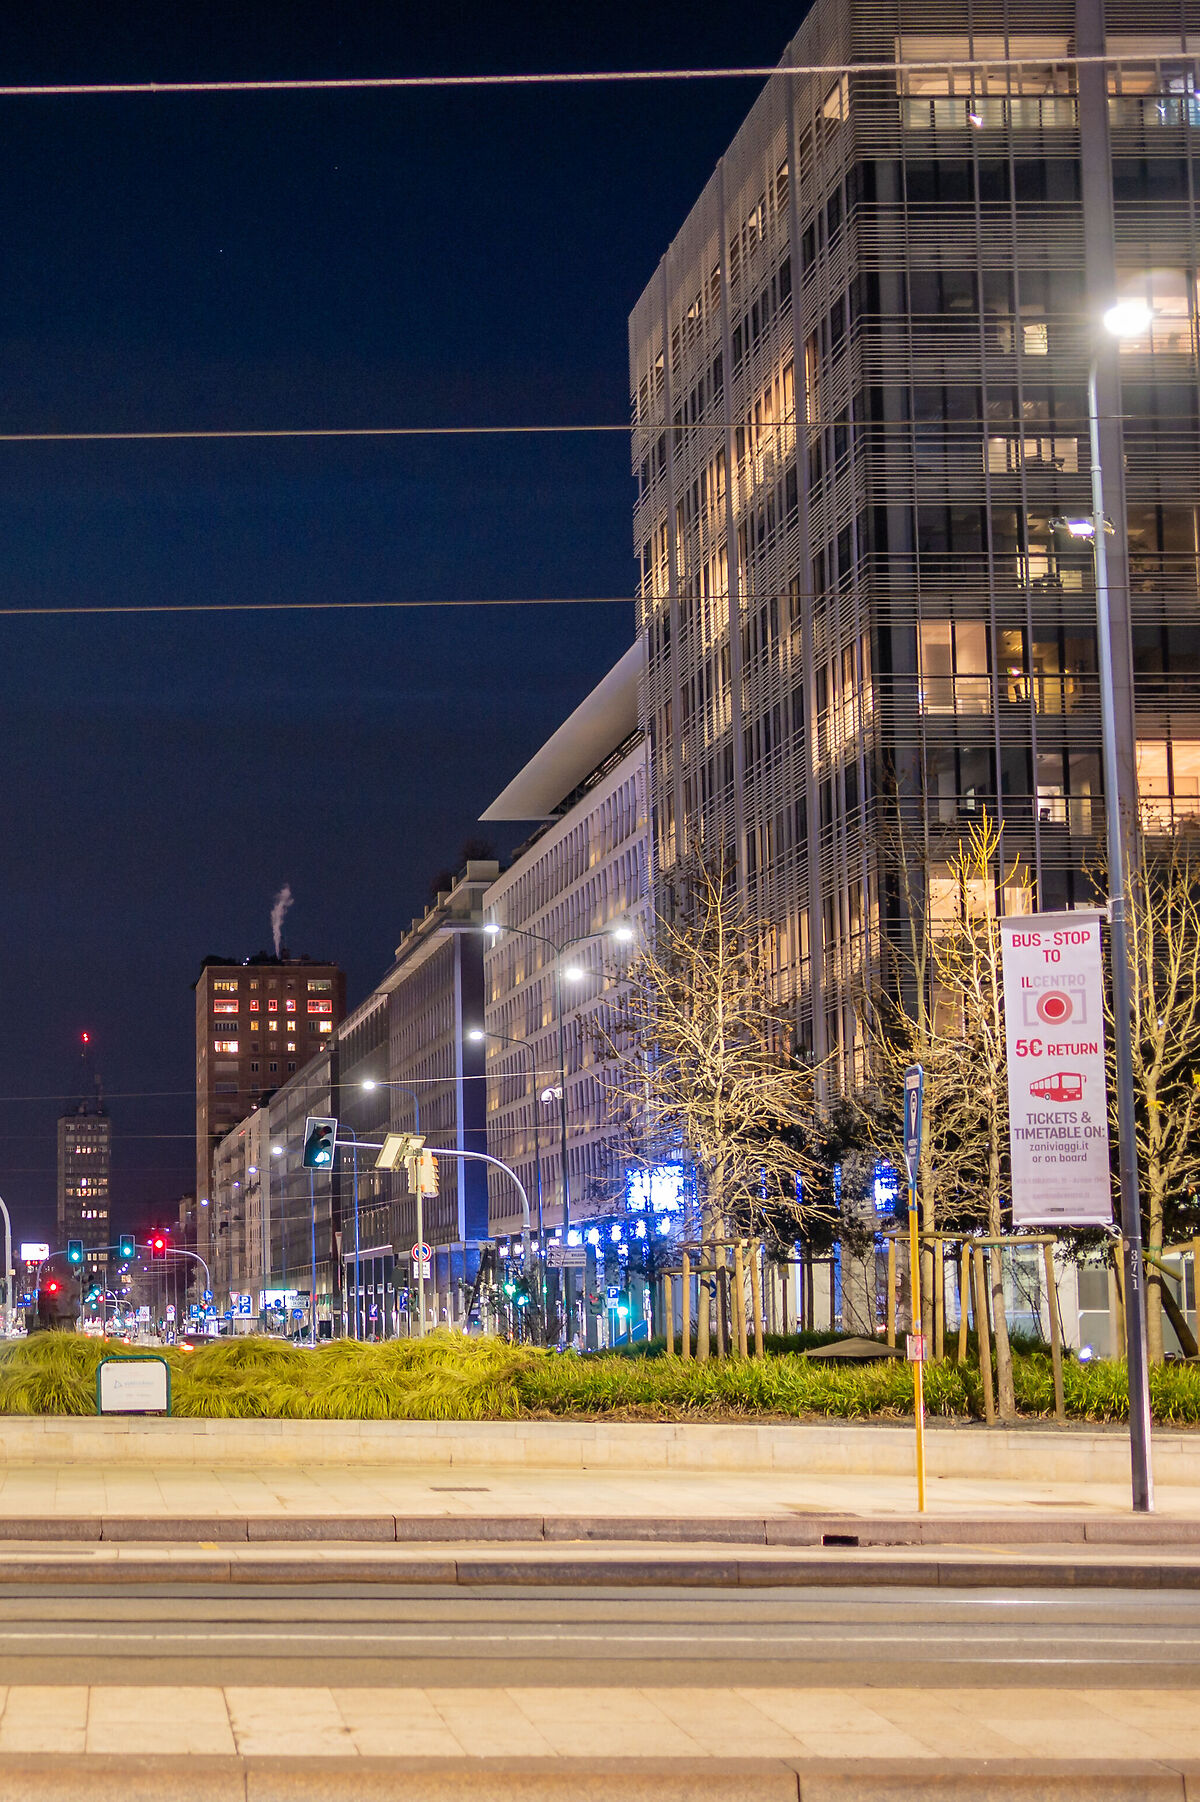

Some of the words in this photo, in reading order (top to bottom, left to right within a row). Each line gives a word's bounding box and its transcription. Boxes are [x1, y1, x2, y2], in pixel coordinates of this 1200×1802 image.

[1012, 933, 1041, 947] BUS
[1053, 930, 1091, 946] STOP
[1042, 949, 1061, 963] TO
[1015, 1038, 1043, 1058] 5€
[1047, 1042, 1099, 1056] RETURN
[1026, 1111, 1078, 1125] TICKETS
[1081, 1111, 1092, 1123] &
[1013, 1126, 1082, 1140] TIMETABLE
[1084, 1126, 1105, 1138] ON:
[1030, 1141, 1089, 1153] zaniviaggi.it
[1032, 1155, 1042, 1163] or
[1045, 1154, 1057, 1163] on
[1059, 1152, 1088, 1163] board
[609, 1288, 617, 1298] P
[241, 1296, 249, 1306] P
